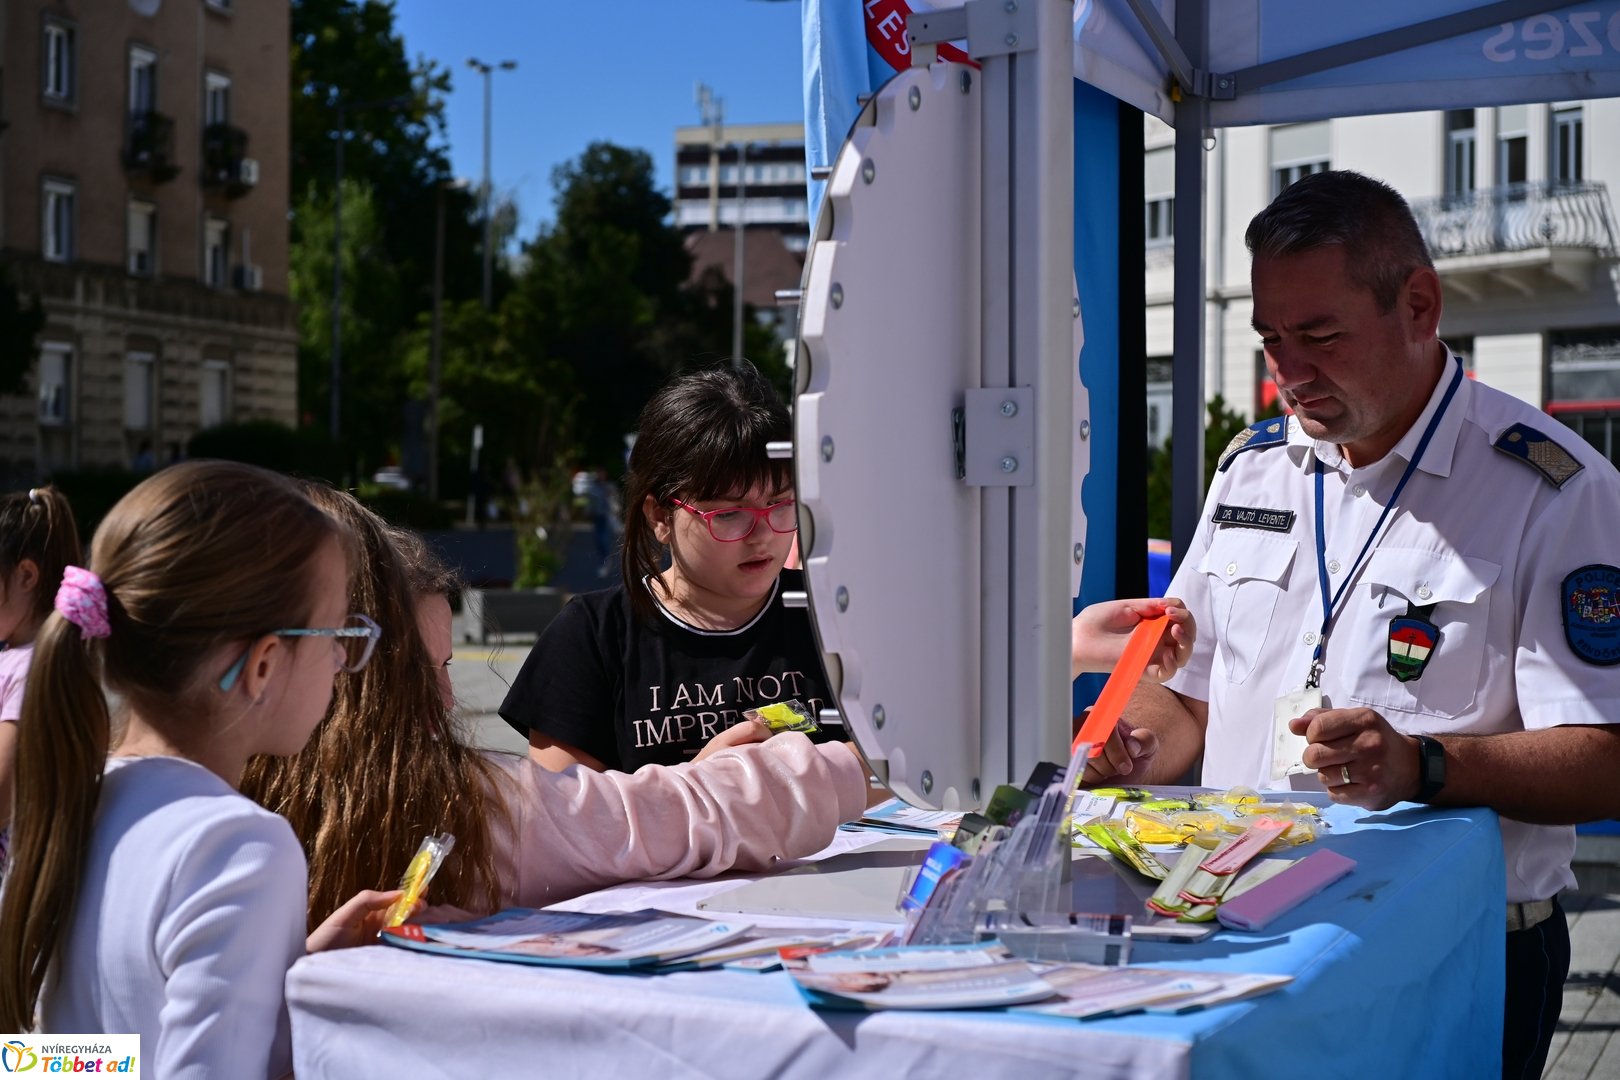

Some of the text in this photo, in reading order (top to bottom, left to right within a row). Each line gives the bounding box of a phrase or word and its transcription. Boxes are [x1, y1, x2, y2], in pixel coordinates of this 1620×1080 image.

[650, 671, 805, 712] I AM NOT
